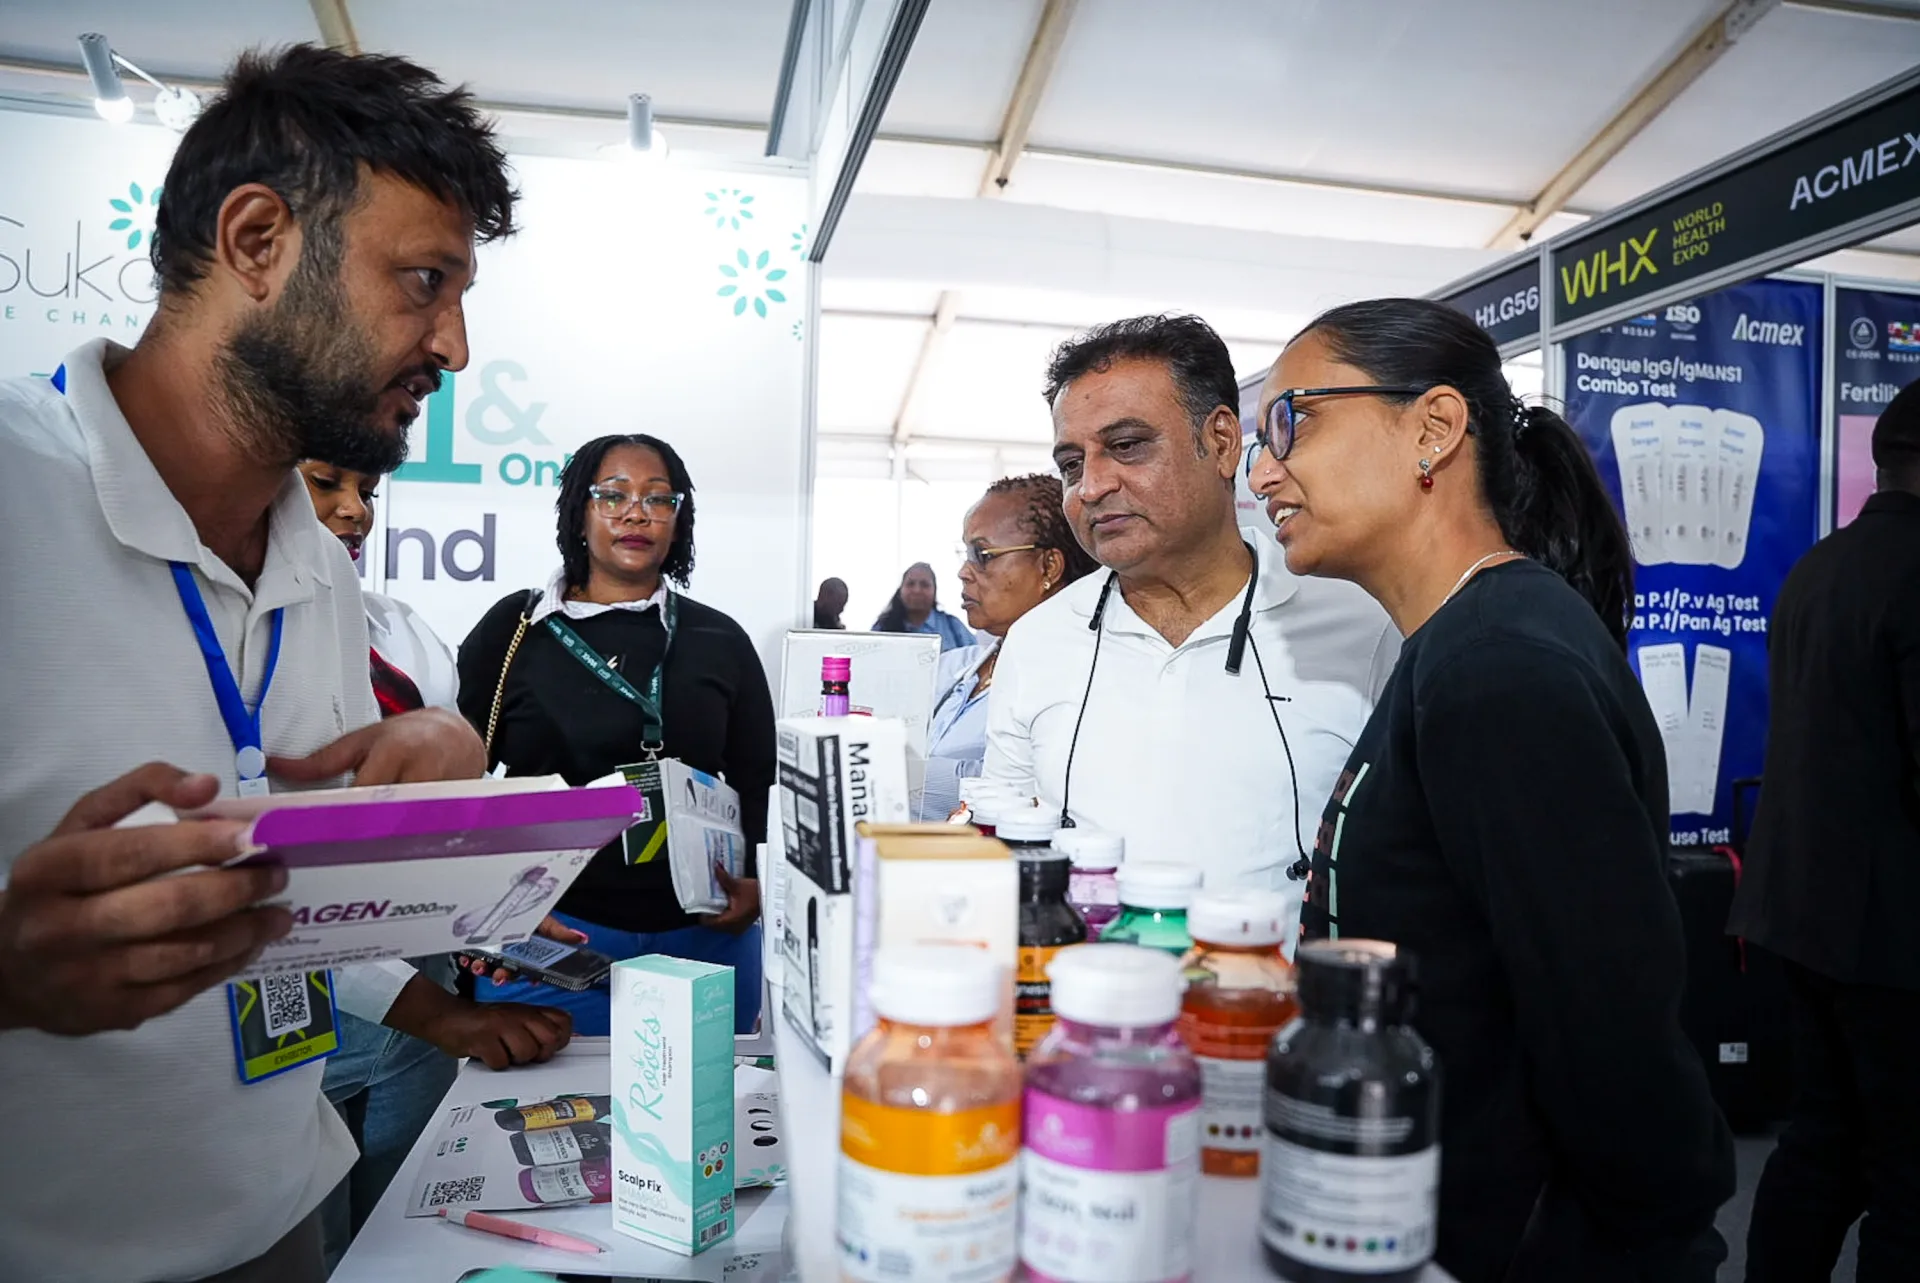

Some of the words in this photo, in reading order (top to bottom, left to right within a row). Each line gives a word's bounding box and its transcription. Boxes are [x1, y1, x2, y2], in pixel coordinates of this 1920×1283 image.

[1673, 203, 1722, 232] WORLD
[1673, 218, 1726, 250] HEALTH
[1561, 228, 1659, 304] WHX
[1673, 241, 1709, 266] EXPO
[1475, 285, 1539, 330] H1.G56
[1665, 305, 1701, 324] ISO
[1732, 313, 1804, 346] Acmex
[1577, 352, 1641, 377] Dengue
[1577, 374, 1639, 396] Combo
[1641, 379, 1677, 398] Test
[465, 359, 553, 446] &
[1648, 587, 1704, 612] P.f/P.v
[1706, 593, 1725, 615] Ag
[1727, 594, 1759, 611] Test
[1648, 609, 1710, 633] P.f/Pan
[1713, 615, 1731, 636] Ag
[1734, 615, 1767, 632] Test
[847, 742, 871, 828] Mana
[1701, 827, 1729, 845] Test
[629, 1010, 664, 1121] Roots
[618, 1169, 646, 1190] Scalp
[647, 1179, 662, 1193] Fix
